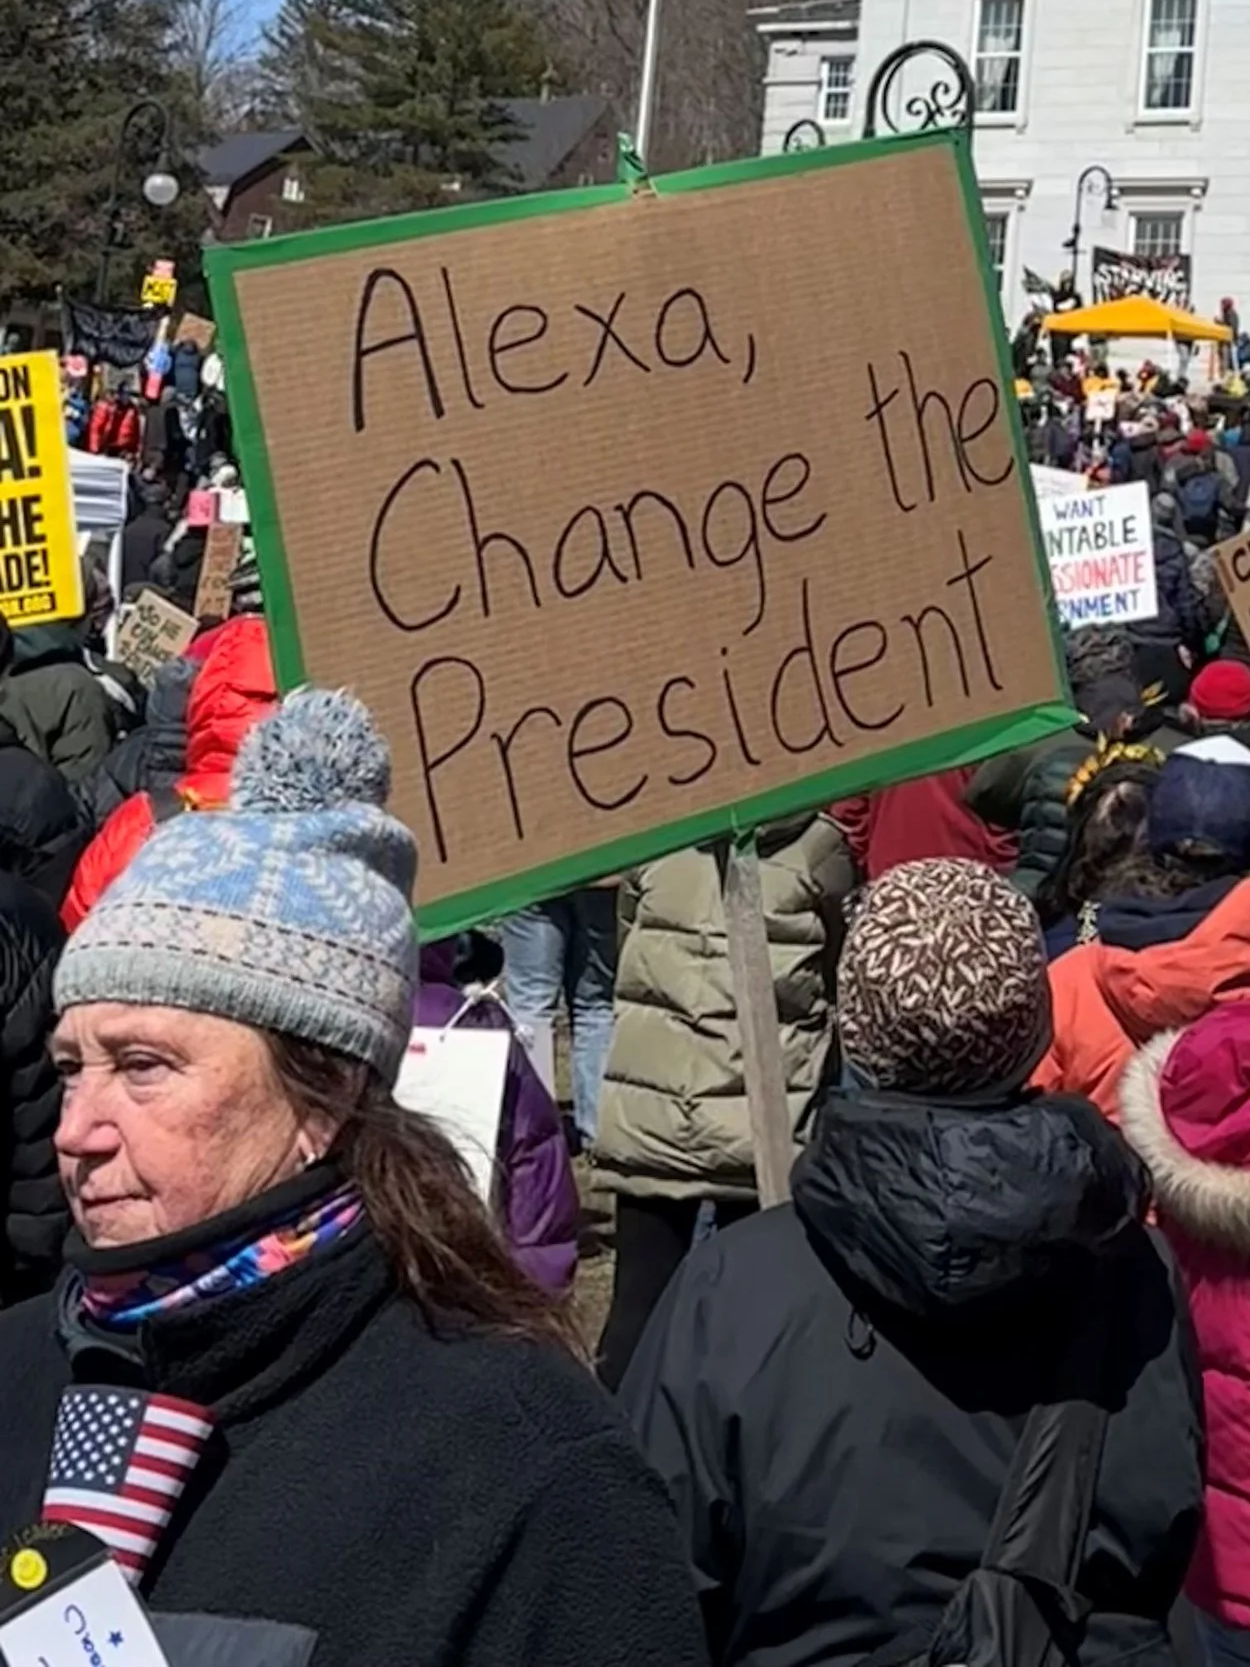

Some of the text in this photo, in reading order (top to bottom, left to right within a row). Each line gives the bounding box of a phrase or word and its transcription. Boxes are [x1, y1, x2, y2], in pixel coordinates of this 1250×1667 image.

[352, 265, 757, 433] Alexa,
[369, 452, 827, 636] Change
[865, 351, 1015, 511] the
[1053, 495, 1106, 521] WANT
[410, 530, 1003, 863] President
